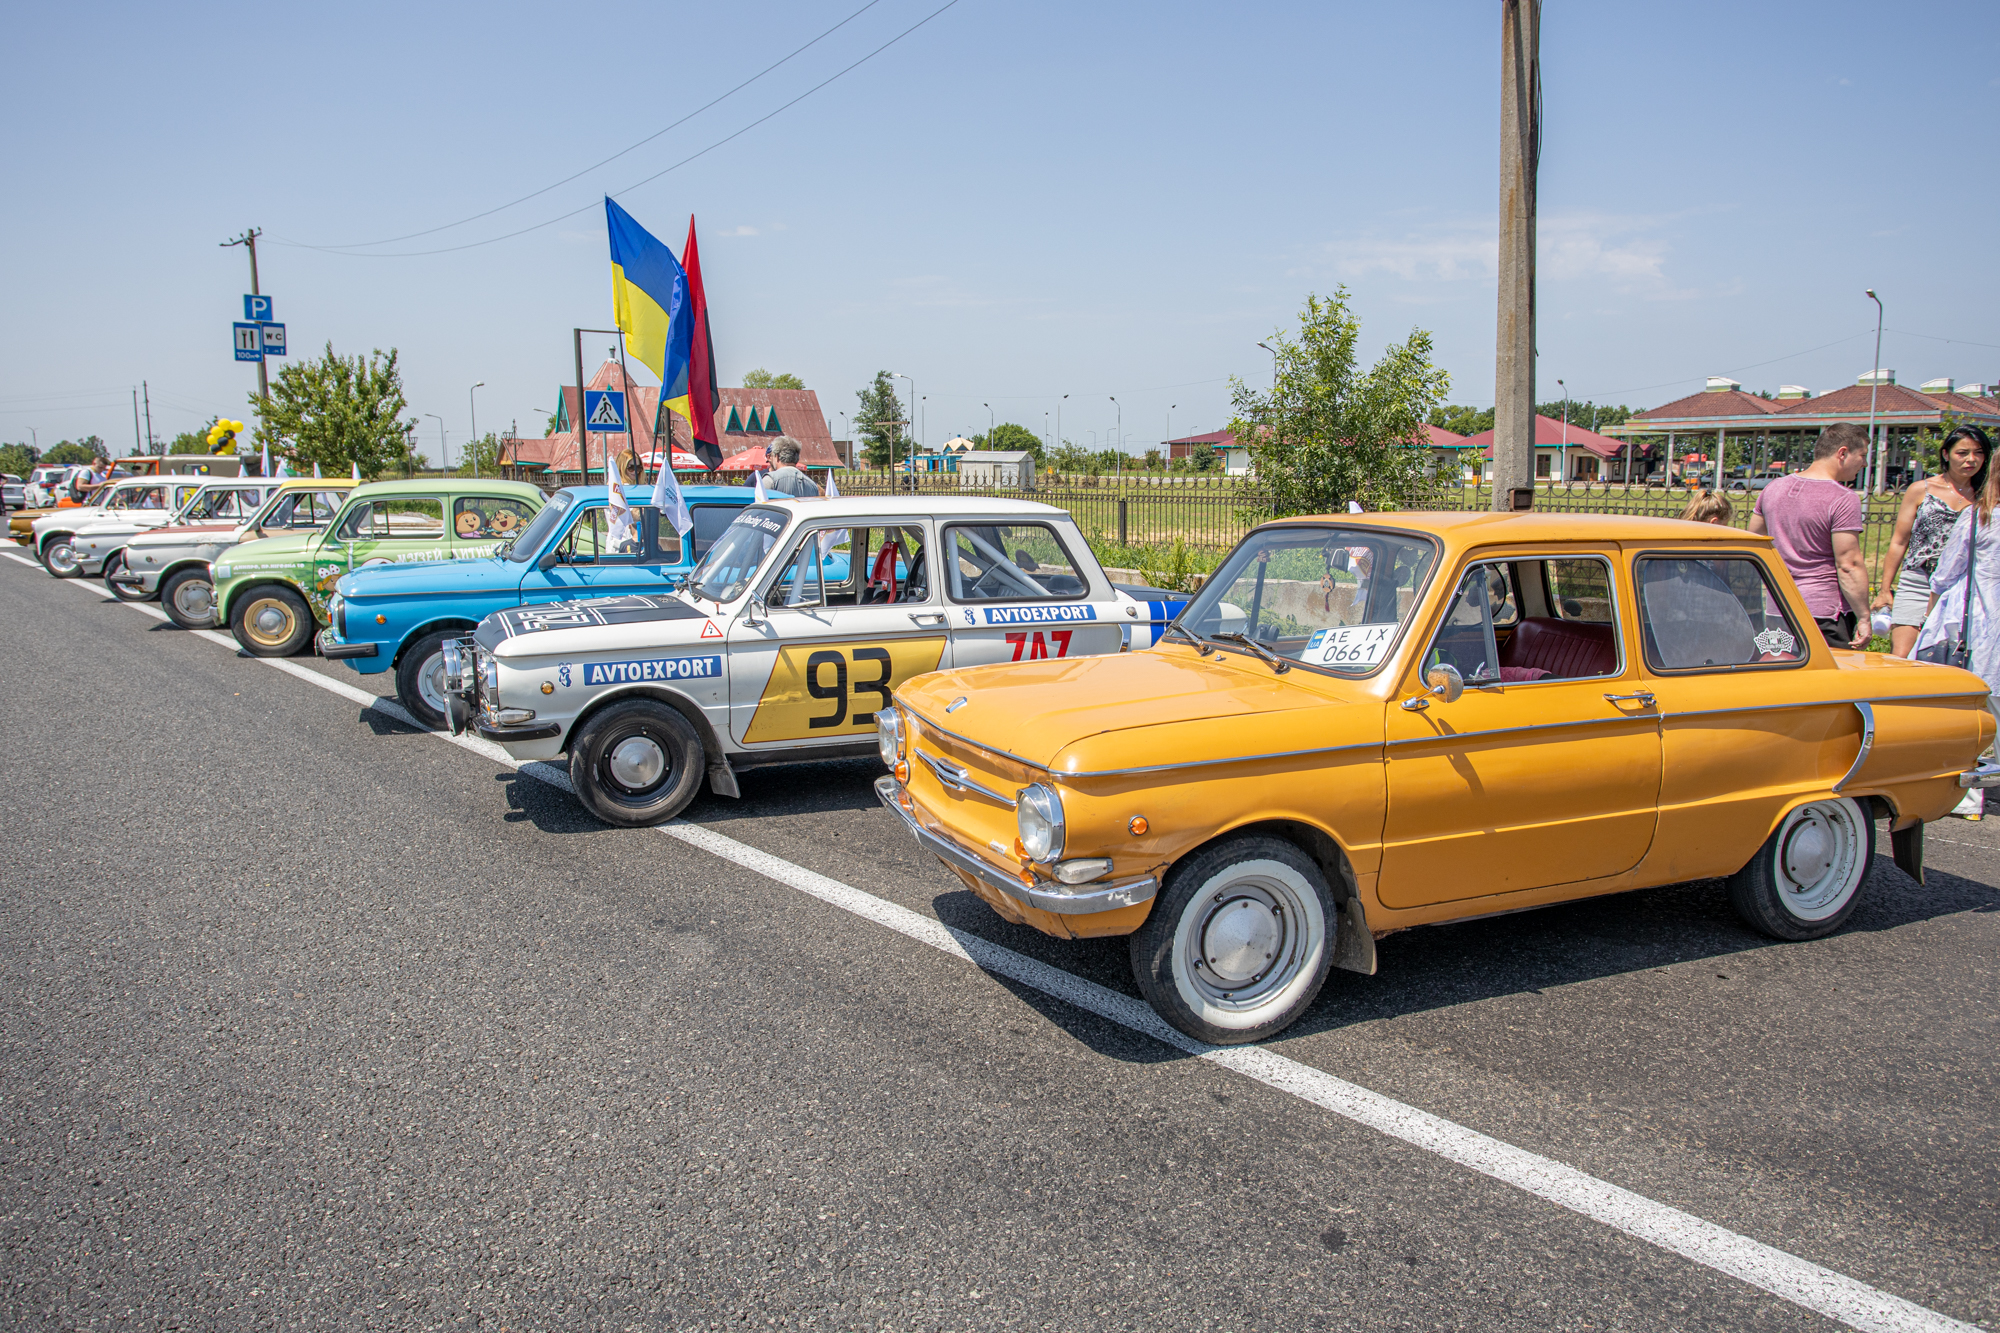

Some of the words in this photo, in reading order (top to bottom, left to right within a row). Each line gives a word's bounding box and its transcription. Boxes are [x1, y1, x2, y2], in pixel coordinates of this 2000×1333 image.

[251, 298, 267, 318] P
[265, 333, 282, 341] WC
[759, 517, 781, 532] Team
[991, 606, 1089, 622] AVTOEXPORT
[1326, 631, 1351, 644] AE
[1365, 628, 1389, 641] IX
[1323, 643, 1377, 662] 0661
[591, 658, 713, 683] AVTOEXPORT
[806, 647, 894, 729] 93
